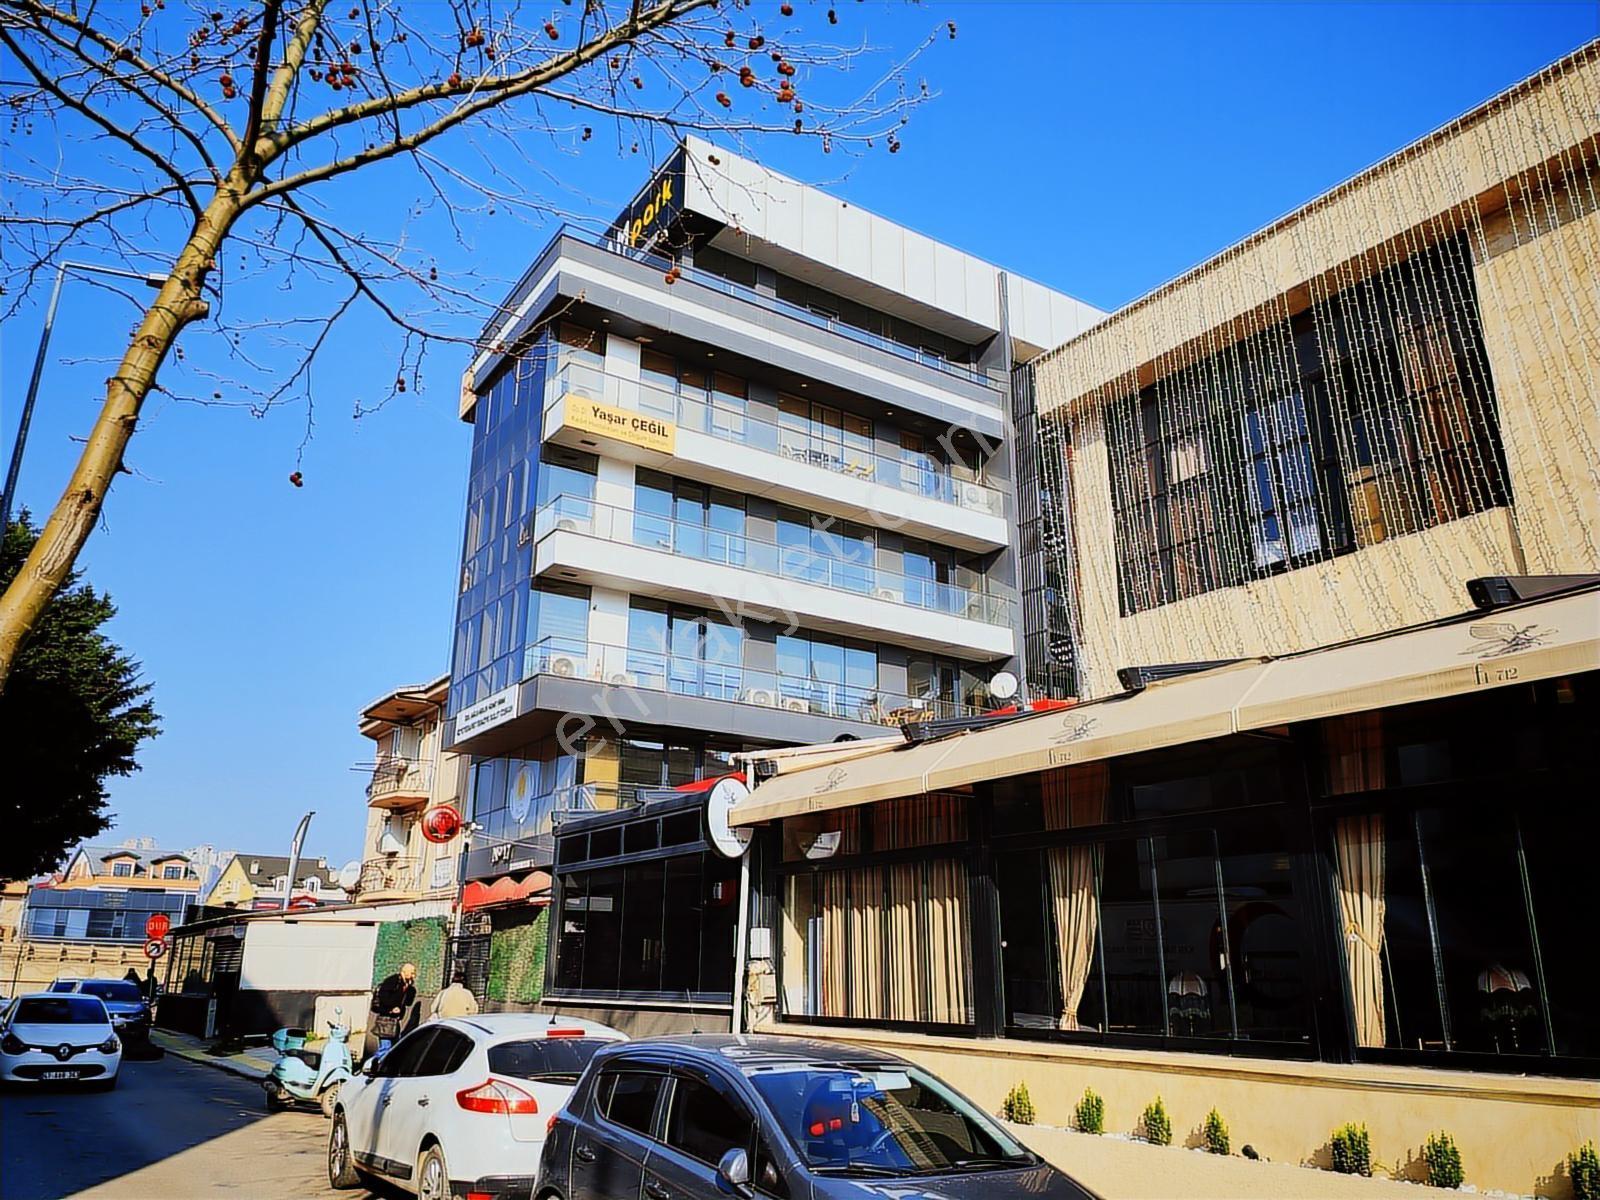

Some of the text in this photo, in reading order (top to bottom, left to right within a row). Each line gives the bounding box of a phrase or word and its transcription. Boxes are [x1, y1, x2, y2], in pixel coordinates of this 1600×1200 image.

[592, 406, 628, 425] Yaşar
[631, 417, 669, 438] ÇEĞİL
[148, 921, 168, 931] DUR
